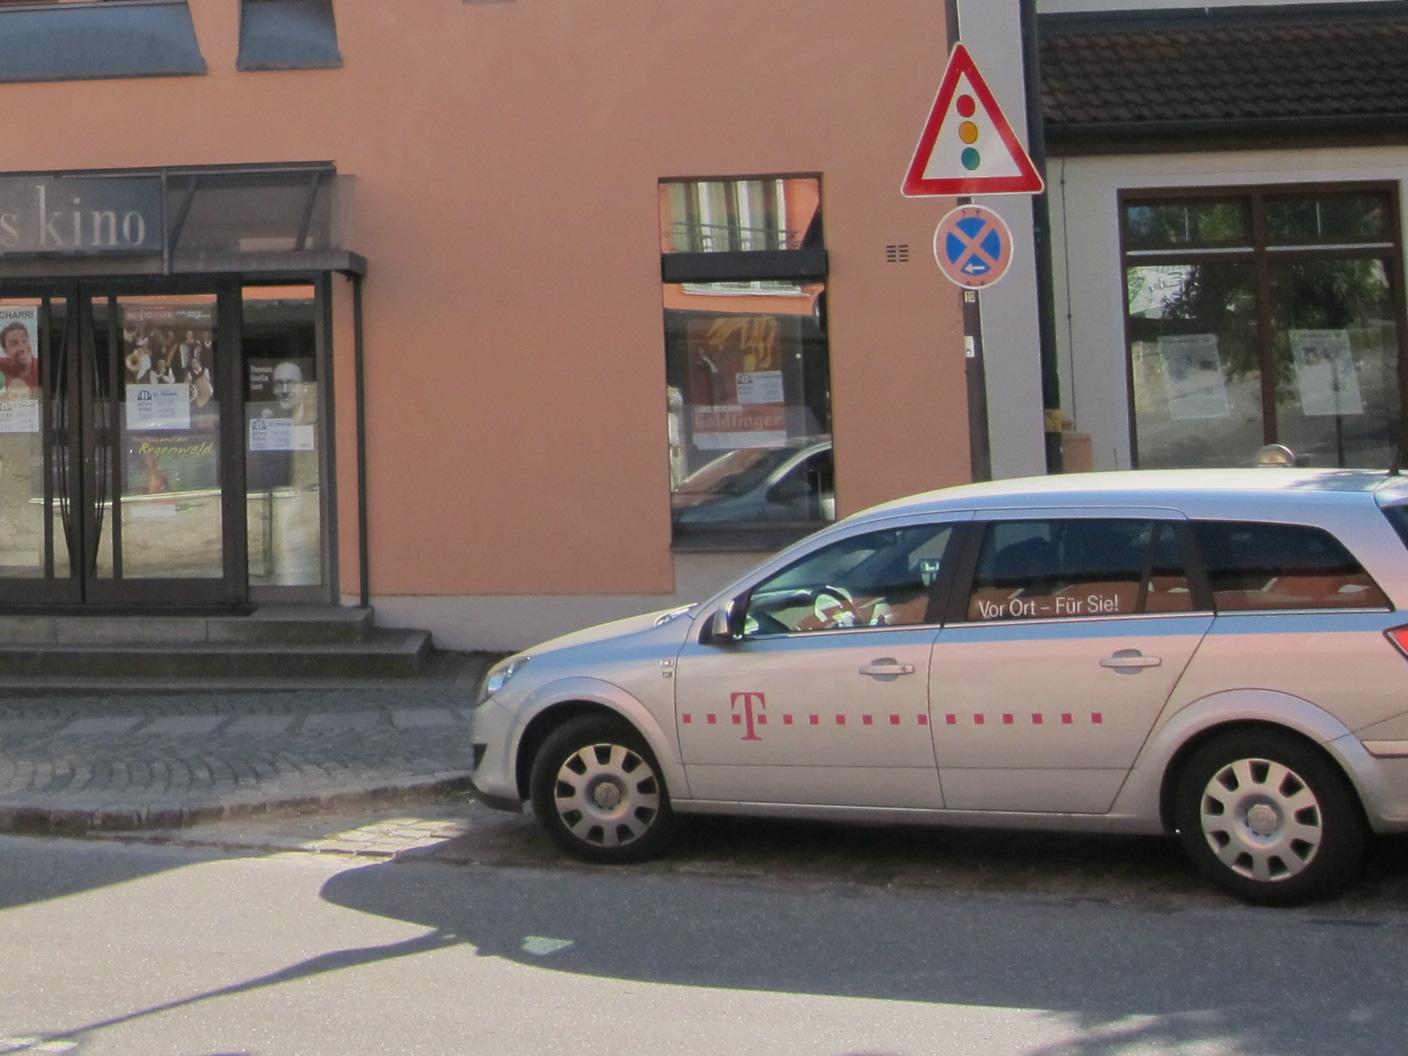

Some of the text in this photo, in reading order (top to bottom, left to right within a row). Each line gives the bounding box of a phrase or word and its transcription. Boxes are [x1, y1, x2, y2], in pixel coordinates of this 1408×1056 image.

[35, 185, 146, 246] kino
[978, 600, 1005, 618] Vor
[1009, 598, 1036, 617] Ort
[1055, 596, 1083, 614] Für
[1087, 594, 1118, 613] Sie!
[730, 691, 766, 741] T
